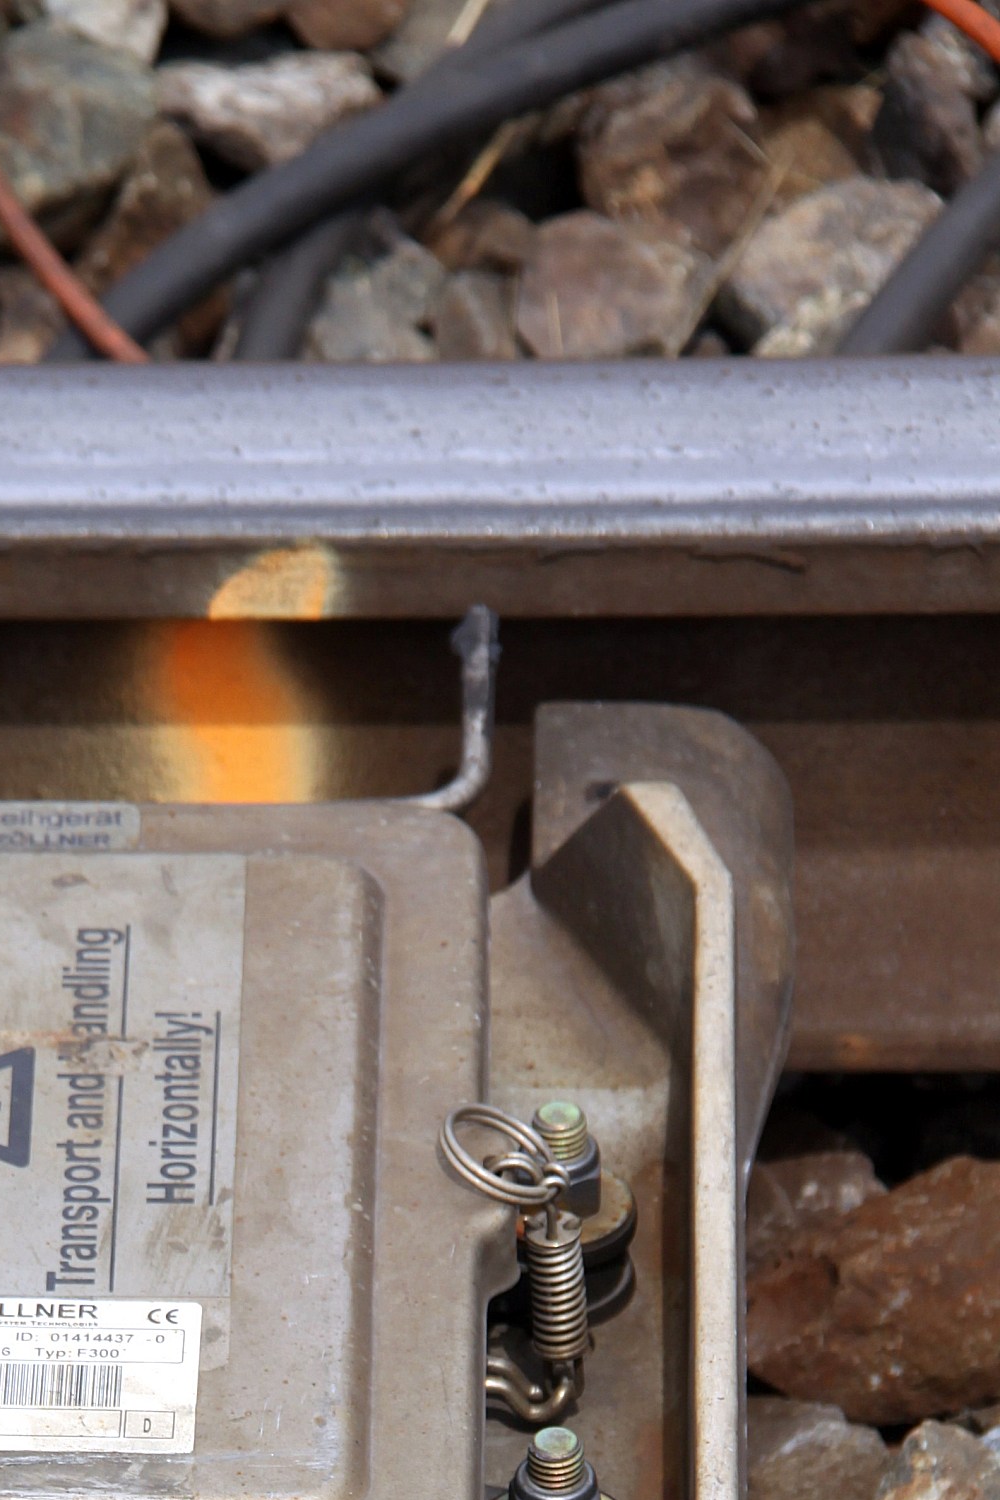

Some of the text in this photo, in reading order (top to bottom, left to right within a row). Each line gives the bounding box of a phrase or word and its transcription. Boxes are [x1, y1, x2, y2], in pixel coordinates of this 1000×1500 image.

[46, 926, 125, 1292] Transport and andling
[146, 1011, 214, 1205] Horizontally!
[15, 1332, 39, 1342] ID:
[50, 1333, 134, 1343] 01414437
[34, 1348, 72, 1359] Typ:
[77, 1349, 120, 1358] F300
[143, 1418, 151, 1433] D
